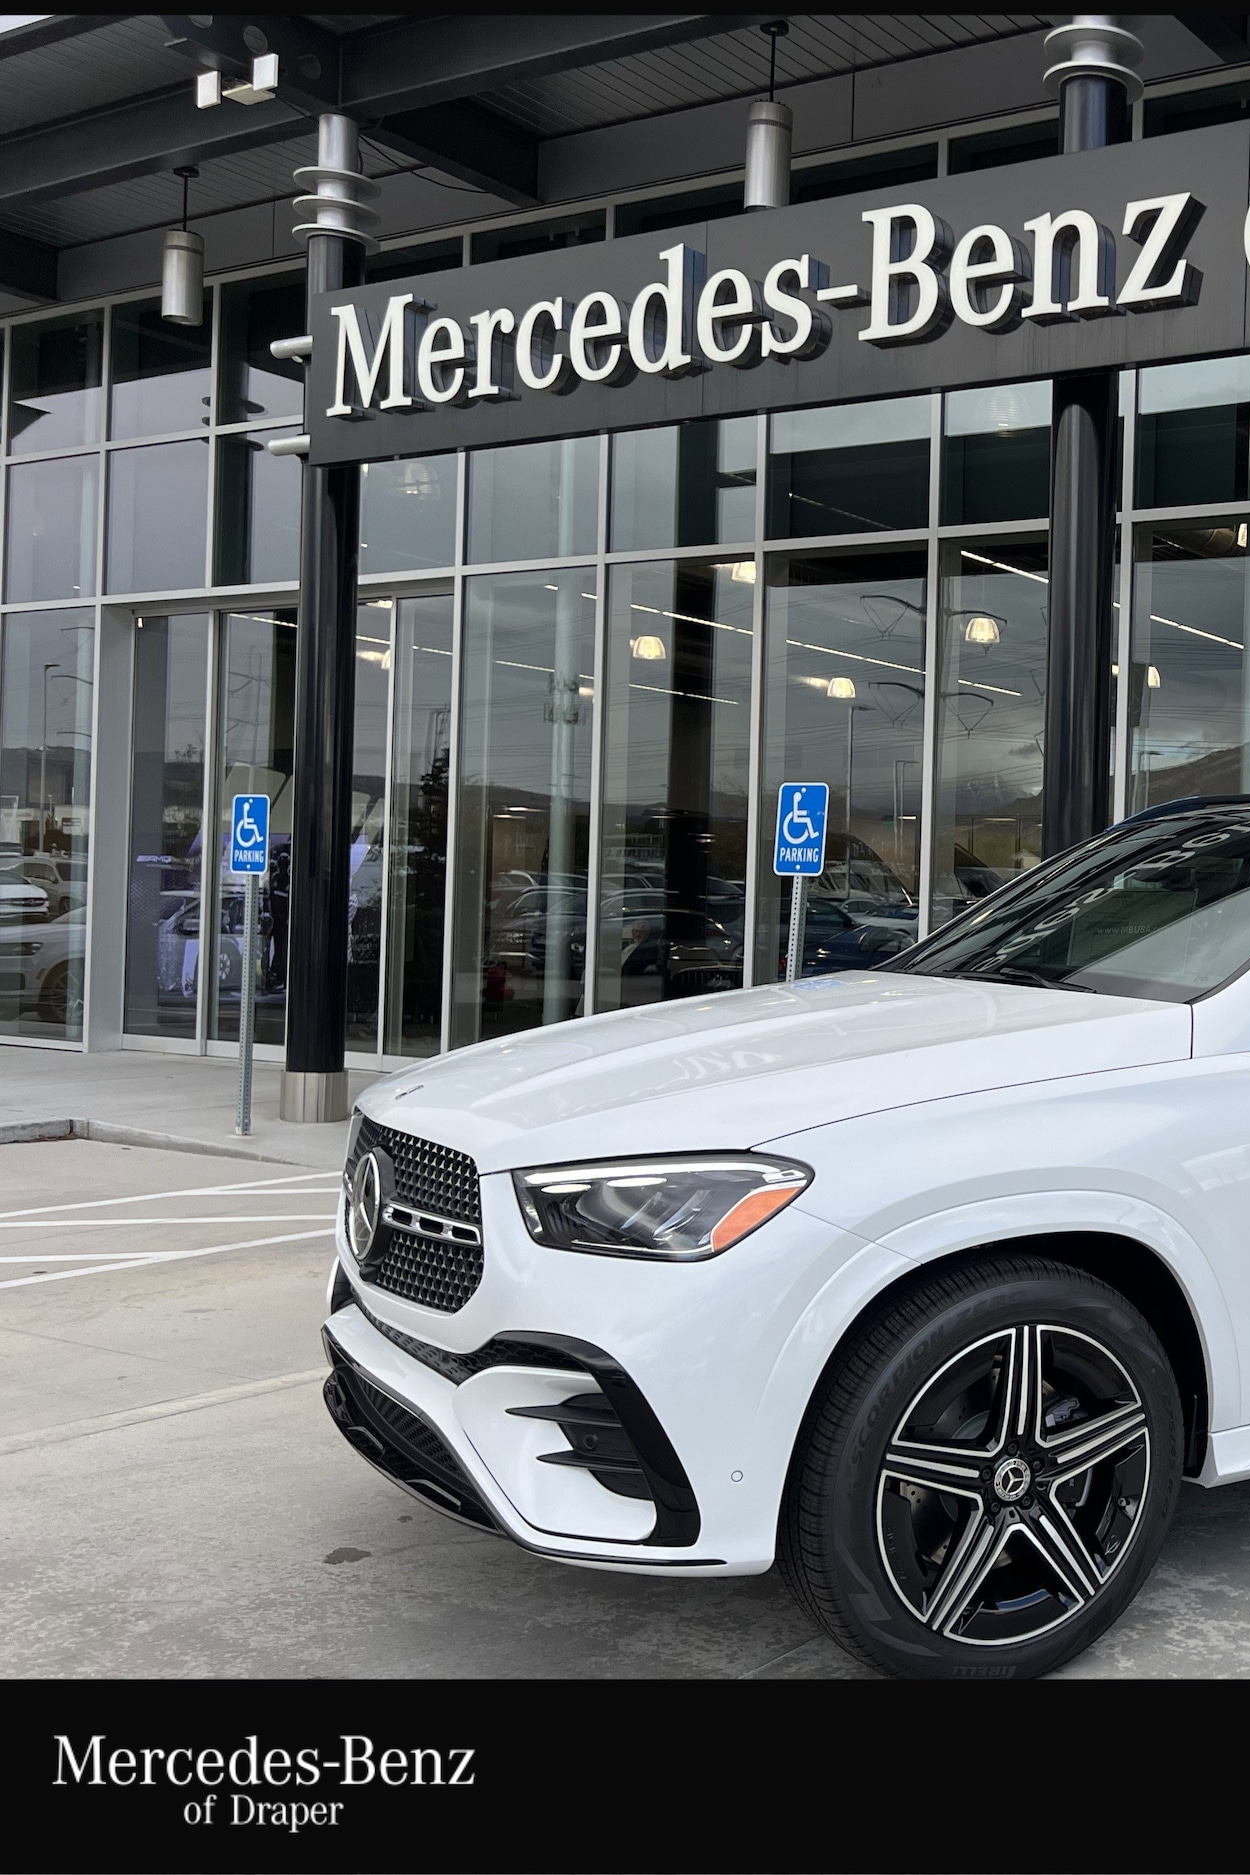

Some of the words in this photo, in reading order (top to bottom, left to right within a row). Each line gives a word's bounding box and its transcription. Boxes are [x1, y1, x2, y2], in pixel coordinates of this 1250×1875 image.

[326, 192, 1191, 418] Mercedes-Benz
[234, 849, 265, 863] PARKING
[779, 847, 820, 863] PARKING
[851, 1323, 945, 1467] SCORPION
[949, 1665, 1018, 1680] PIRELLI
